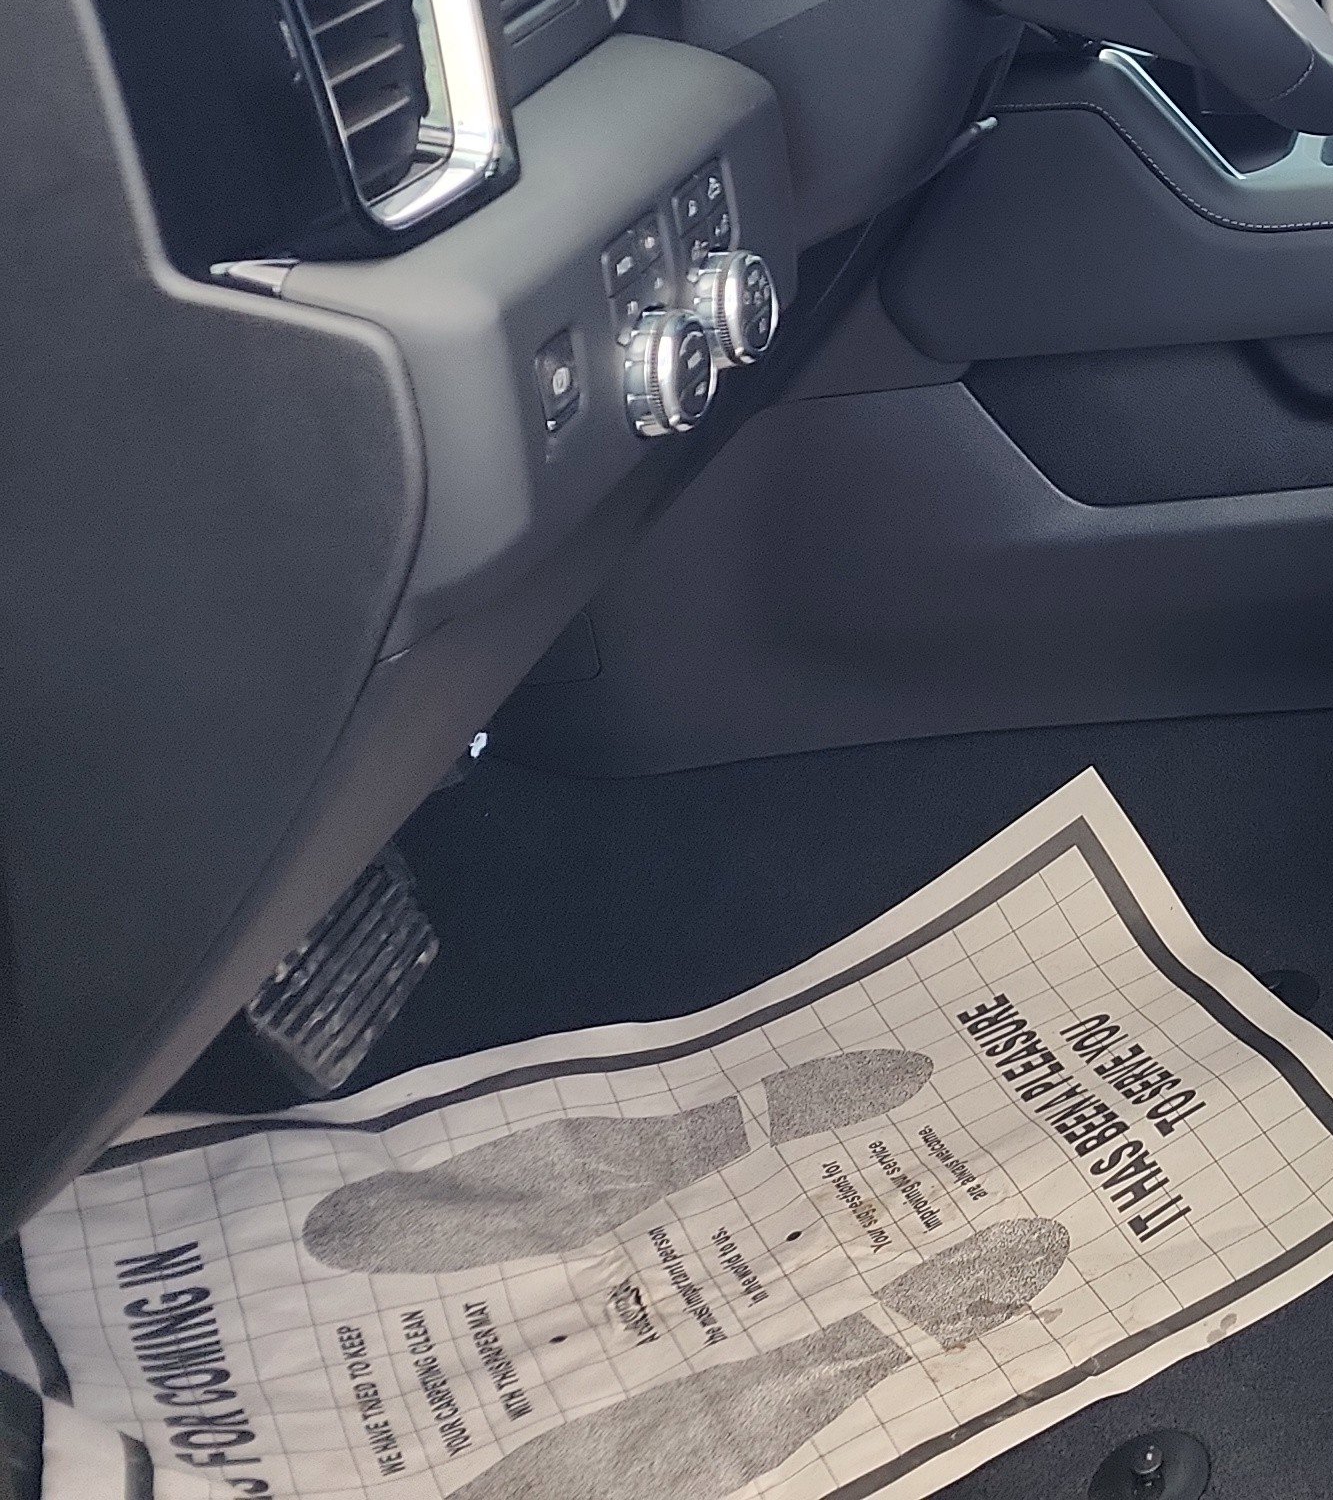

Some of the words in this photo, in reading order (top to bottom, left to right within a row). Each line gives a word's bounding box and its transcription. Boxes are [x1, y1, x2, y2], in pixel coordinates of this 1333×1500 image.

[957, 993, 1065, 1102] PLEASURE
[1059, 1013, 1128, 1064] YOU
[1093, 1043, 1181, 1105] SERVE
[1034, 1075, 1082, 1114] A
[1145, 1088, 1206, 1137] TO
[1045, 1094, 1130, 1158] BEEN
[822, 1161, 842, 1180] for
[868, 1140, 901, 1176] service
[945, 1159, 977, 1186] always
[1089, 1139, 1170, 1213] HAS
[901, 1181, 943, 1234] improving
[966, 1183, 988, 1201] are
[1127, 1194, 1192, 1243] IT
[648, 1225, 684, 1264] person
[717, 1243, 737, 1258] to
[867, 1227, 892, 1253] Your
[114, 1241, 204, 1289] IN
[720, 1253, 749, 1280] world
[463, 1300, 492, 1331] MAT
[747, 1291, 769, 1308] in
[123, 1286, 238, 1406] COMING
[336, 1326, 367, 1360] KEEP
[400, 1309, 436, 1355] CLEAN
[703, 1326, 728, 1346] the
[347, 1361, 373, 1380] TO
[413, 1355, 459, 1421] CARPETING
[353, 1382, 385, 1421] TRIED
[500, 1387, 533, 1422] WITH
[163, 1407, 262, 1468] FOR
[365, 1420, 398, 1454] HAVE
[439, 1418, 473, 1457] YOUR
[378, 1451, 406, 1477] WE
